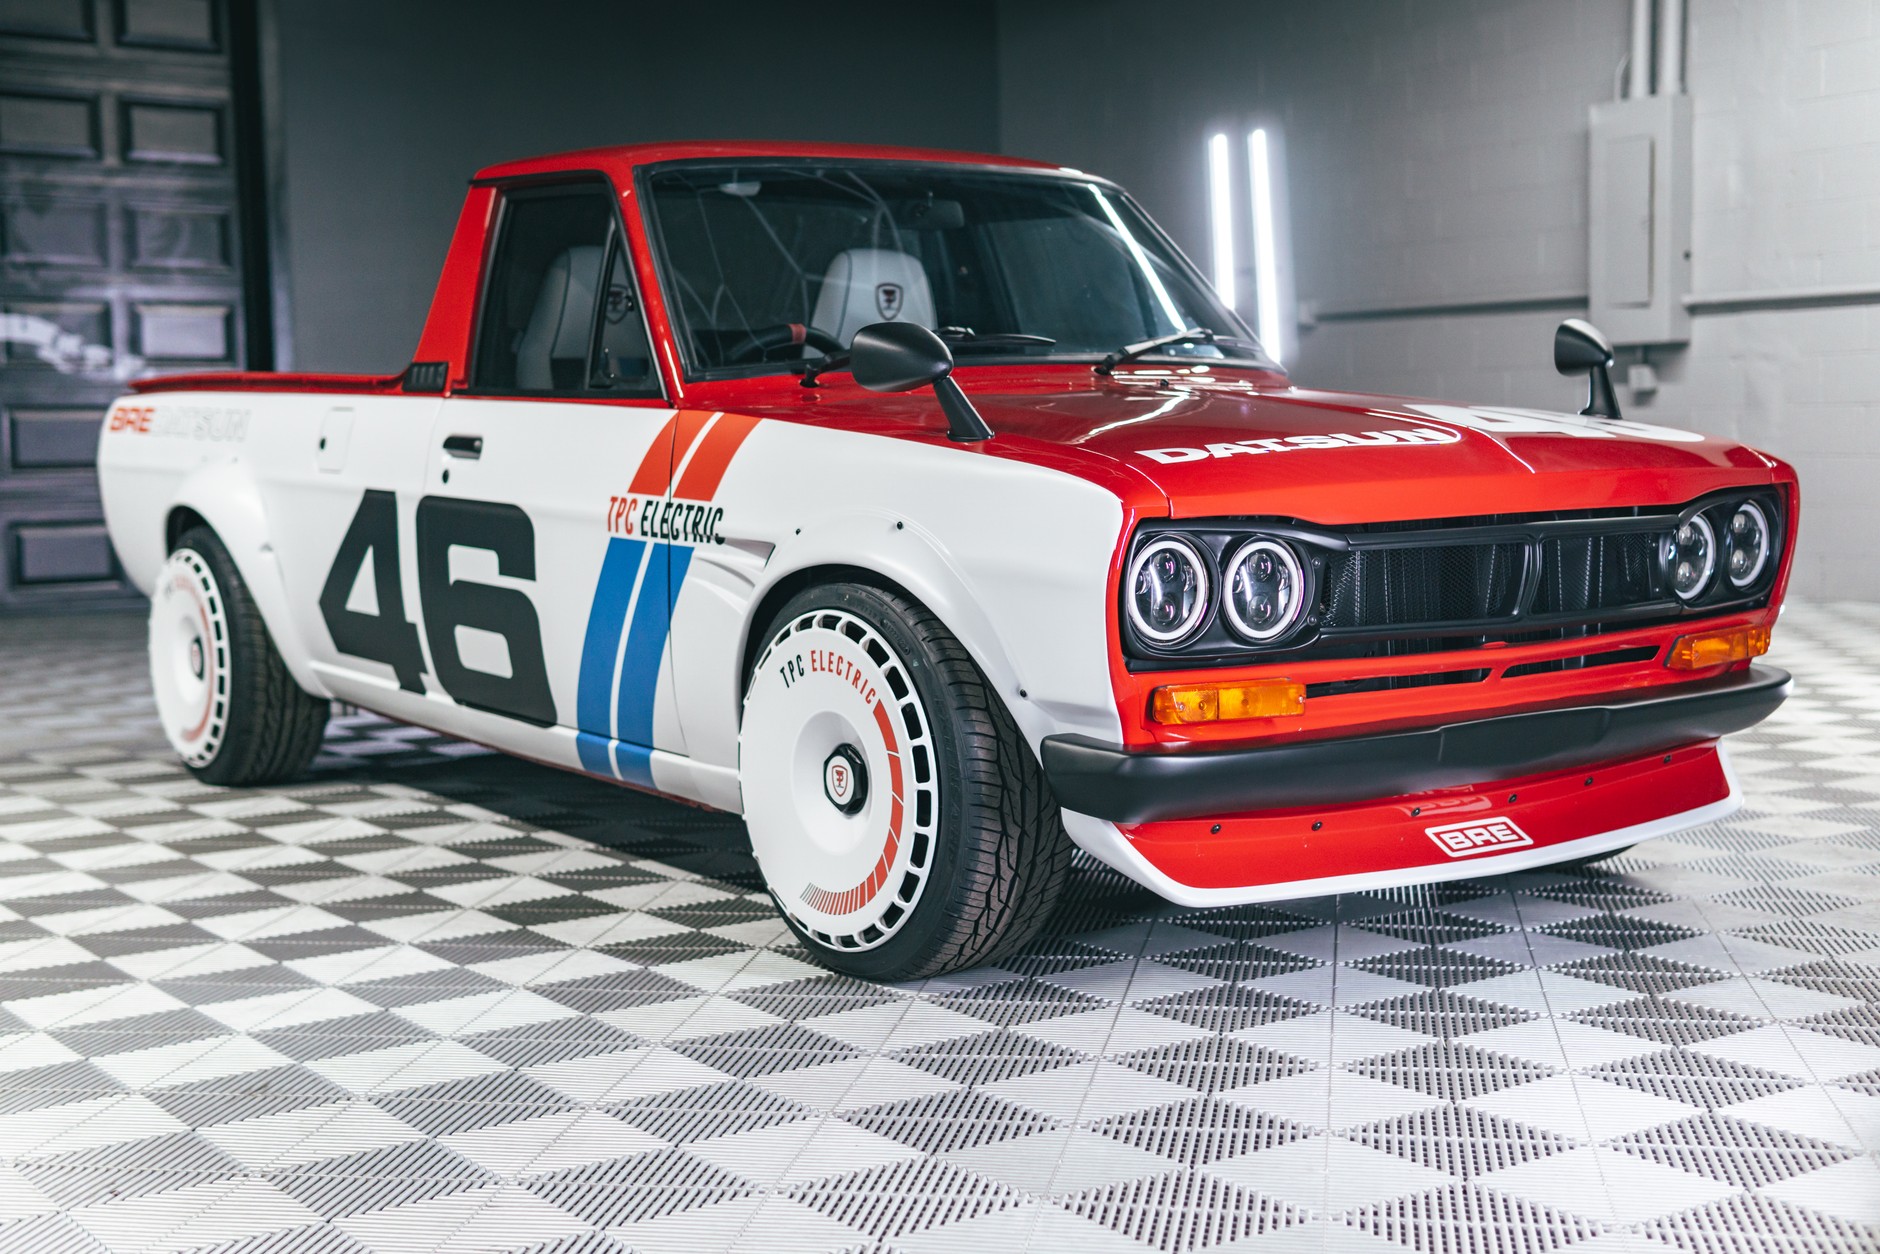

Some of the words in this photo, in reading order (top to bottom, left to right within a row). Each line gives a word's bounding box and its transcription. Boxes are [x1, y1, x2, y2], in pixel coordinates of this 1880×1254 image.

[109, 406, 155, 433] BRE
[1133, 427, 1443, 465] DATSUN
[607, 496, 638, 535] TPC
[640, 499, 726, 545] ELECTRIC
[318, 488, 558, 729] 46
[779, 654, 805, 688] TPC
[810, 650, 876, 705] ELECTRIC
[1439, 823, 1519, 850] BRE
